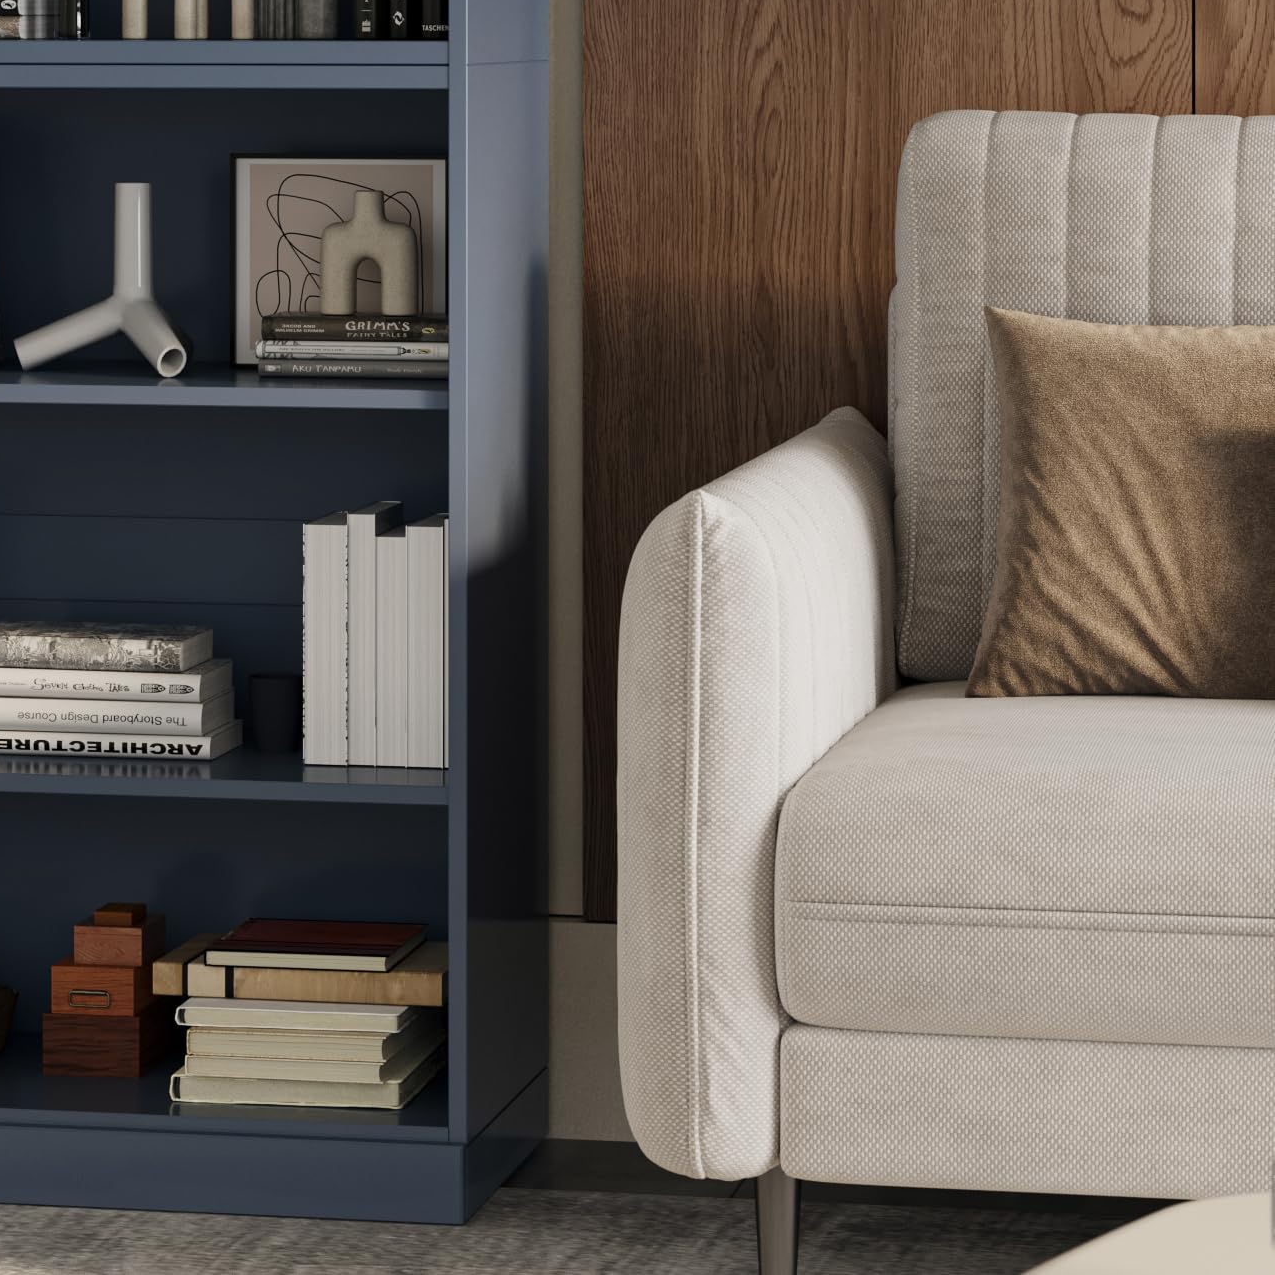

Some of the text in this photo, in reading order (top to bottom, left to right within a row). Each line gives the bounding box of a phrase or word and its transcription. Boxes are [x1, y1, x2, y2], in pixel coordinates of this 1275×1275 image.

[345, 320, 411, 332] GRIMM'S
[291, 364, 312, 373] AKU
[17, 711, 188, 727] The Storyboard Design Course
